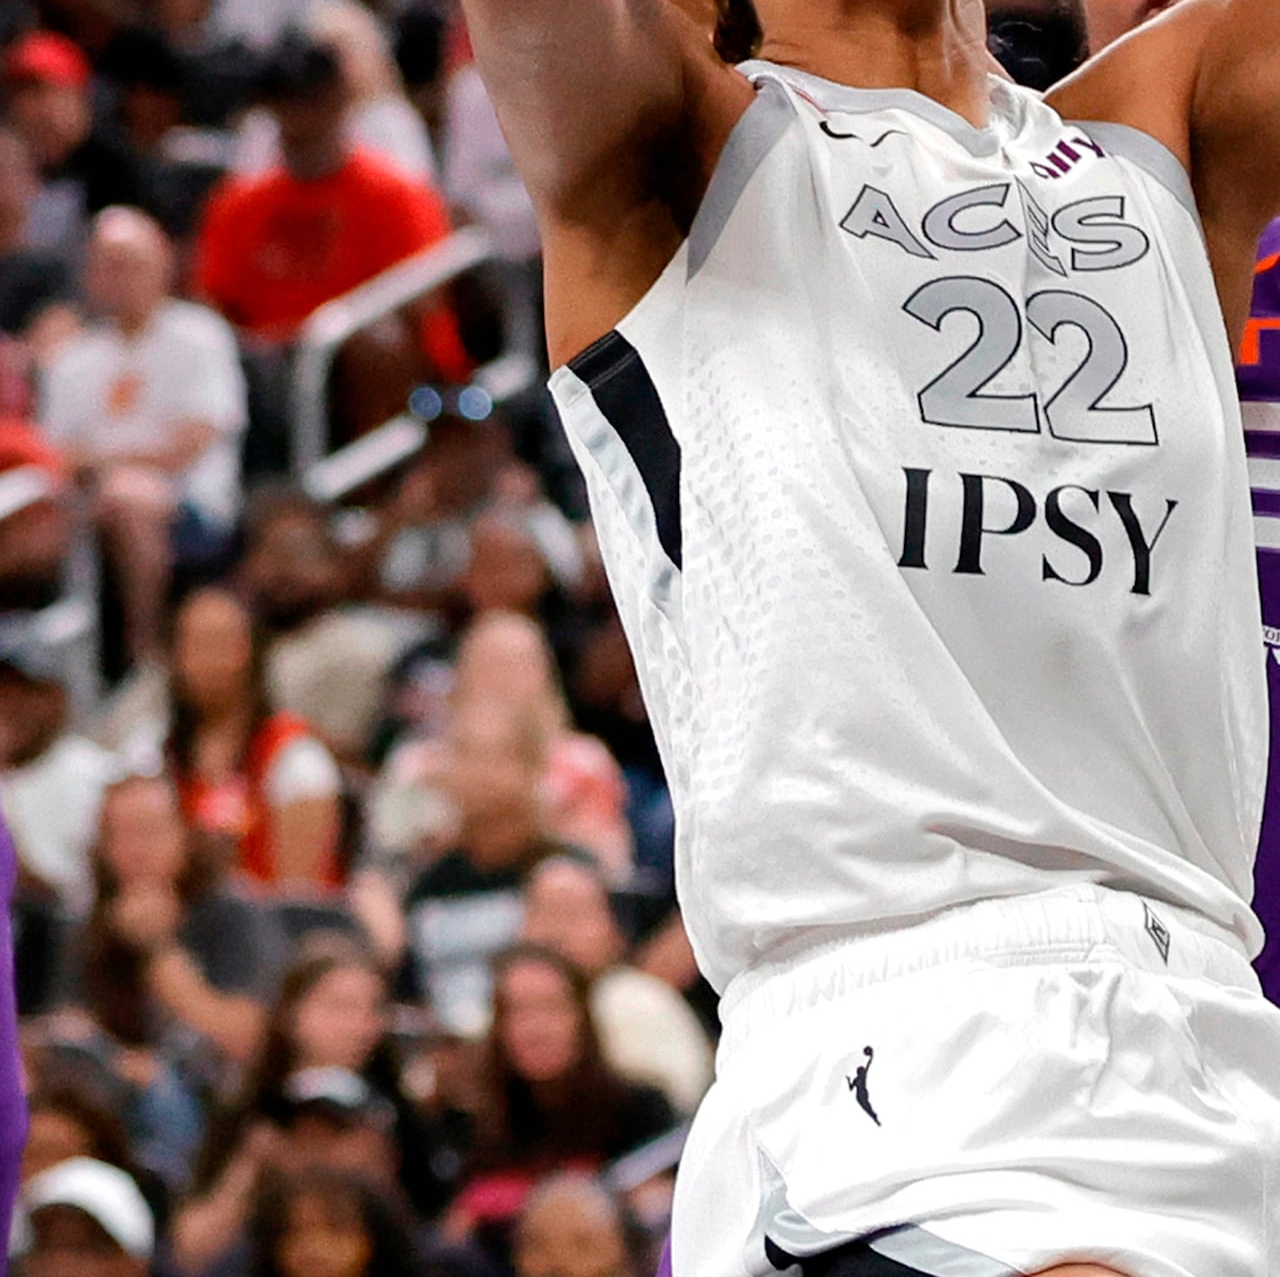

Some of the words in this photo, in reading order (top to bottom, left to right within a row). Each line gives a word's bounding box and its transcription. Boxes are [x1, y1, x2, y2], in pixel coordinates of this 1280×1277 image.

[1028, 136, 1106, 180] ally
[839, 175, 1150, 277] ACES
[902, 275, 1159, 446] 22
[897, 466, 1178, 597] IPSY
